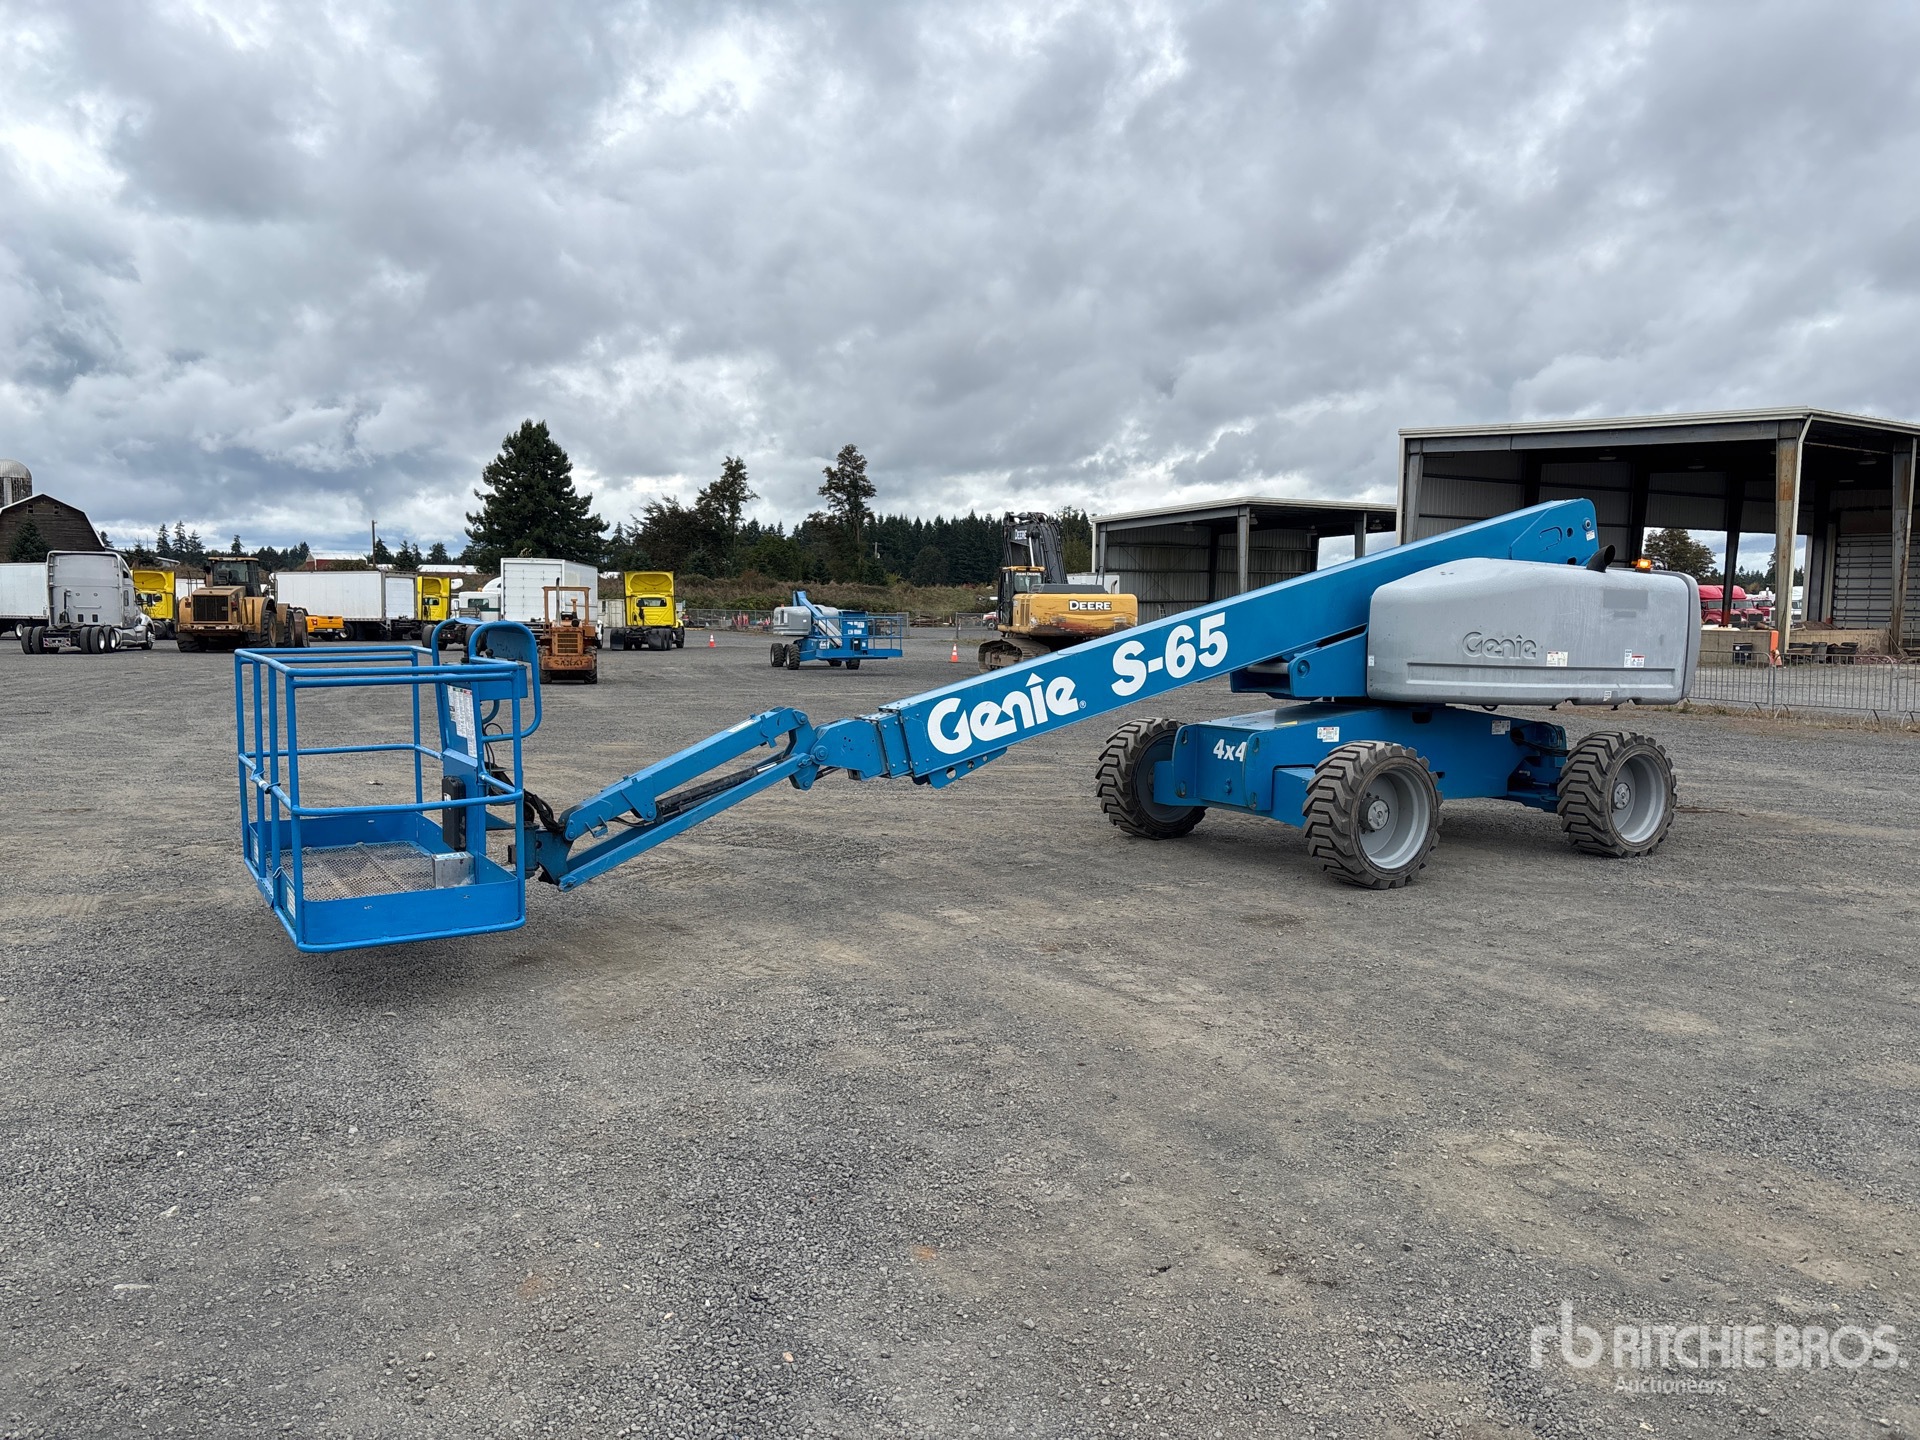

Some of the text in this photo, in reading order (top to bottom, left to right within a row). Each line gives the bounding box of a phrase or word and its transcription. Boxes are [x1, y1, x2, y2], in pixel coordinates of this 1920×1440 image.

[1069, 600, 1112, 611] DEERE
[1110, 612, 1229, 697] S-65
[1462, 631, 1537, 659] Genie
[927, 672, 1079, 754] Genie
[1213, 738, 1247, 762] 4x4
